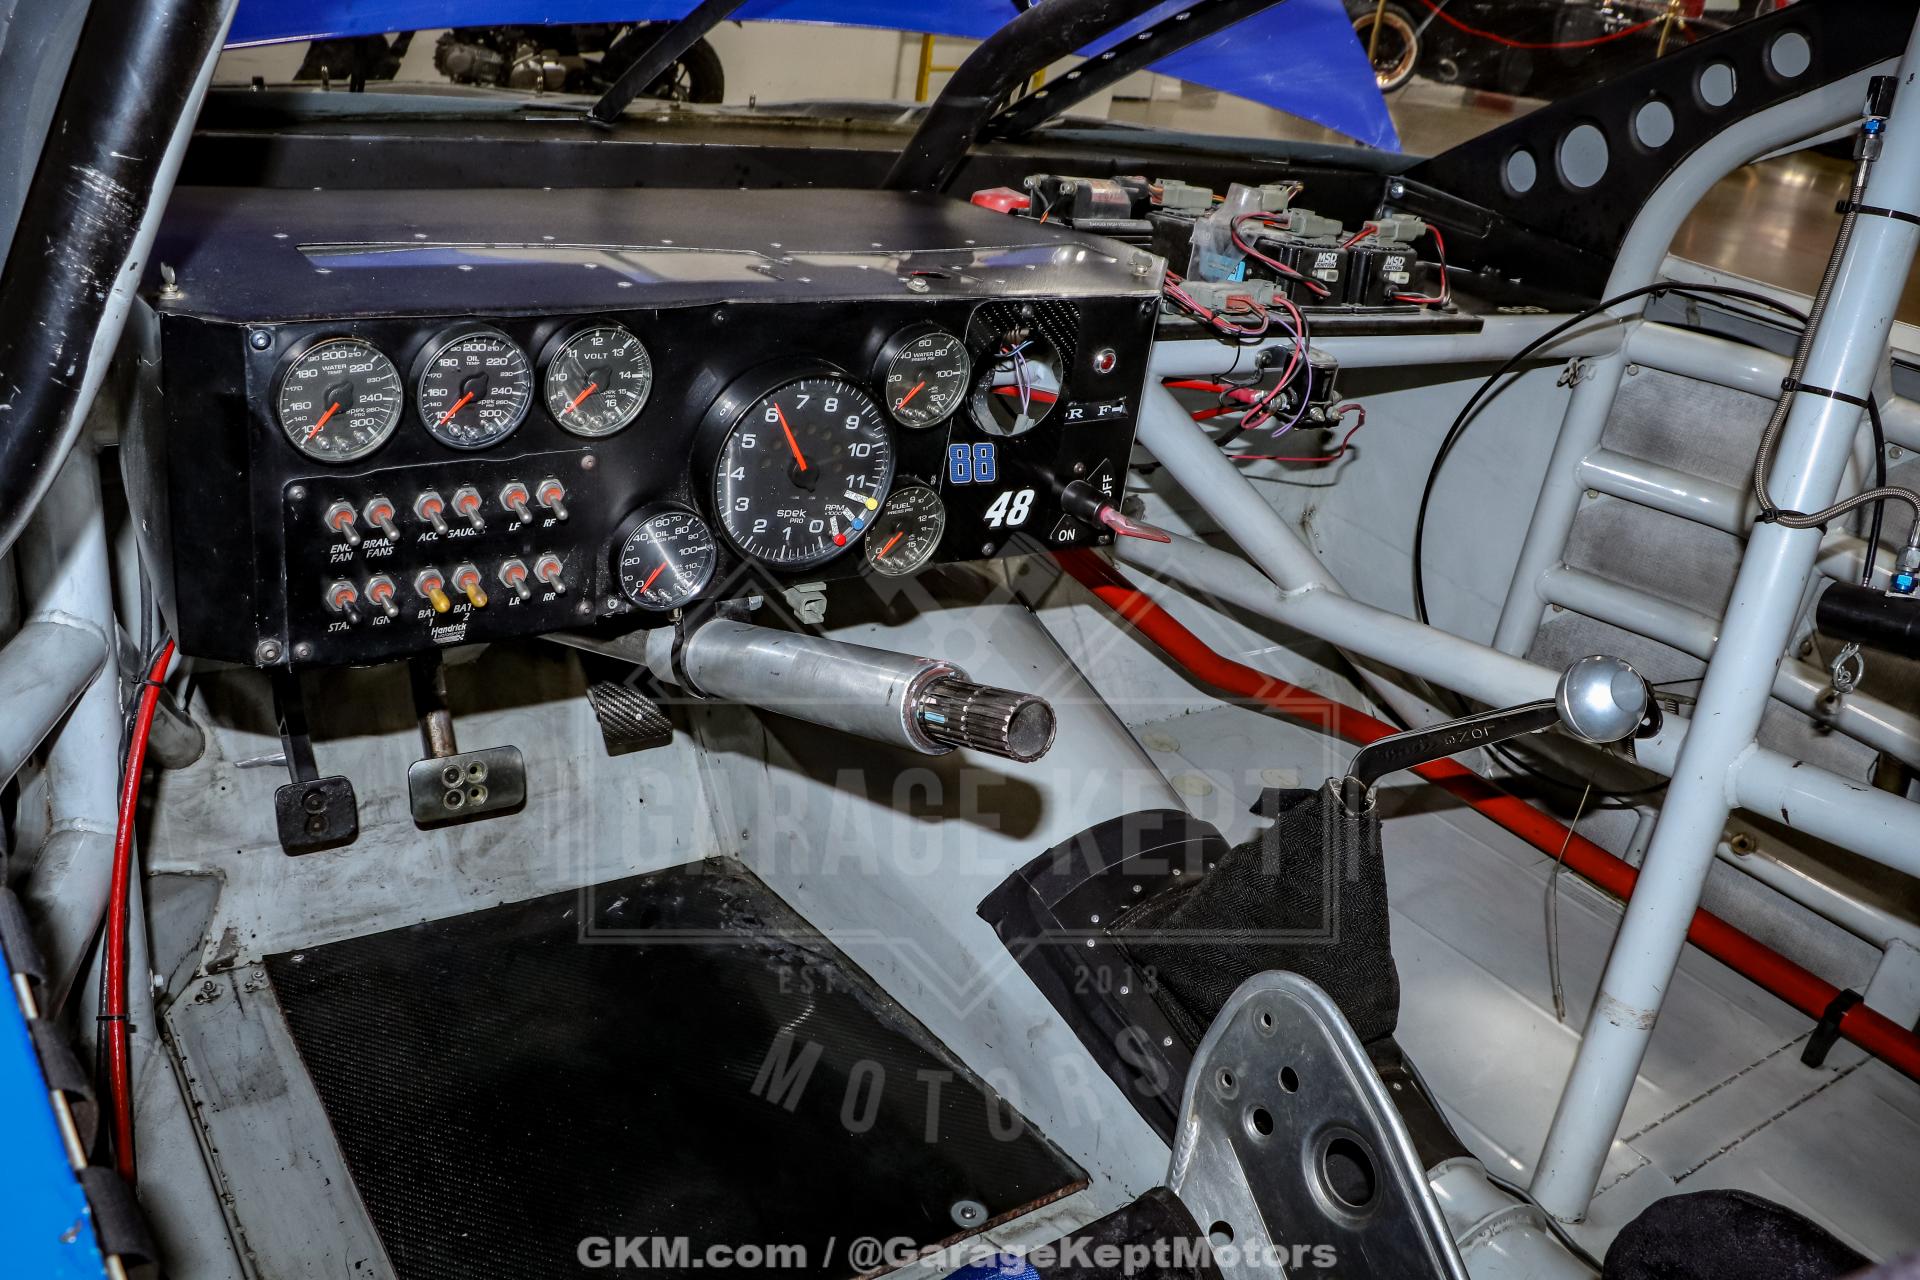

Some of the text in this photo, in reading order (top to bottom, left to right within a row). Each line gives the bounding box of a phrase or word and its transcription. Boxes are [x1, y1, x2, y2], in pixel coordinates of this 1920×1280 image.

[1319, 253, 1338, 262] MSD
[1386, 256, 1405, 265] MSD
[591, 337, 603, 346] 12
[919, 339, 931, 347] 60
[463, 343, 487, 352] 200
[612, 348, 624, 356] 13
[322, 351, 347, 360] 200
[567, 350, 577, 358] 11
[935, 349, 947, 357] 80
[438, 358, 458, 367] 180
[486, 358, 508, 366] 220
[350, 363, 373, 373] 220
[296, 369, 318, 379] 180
[554, 373, 568, 381] 10
[619, 371, 631, 379] 14
[889, 374, 902, 382] 20
[936, 370, 952, 378] 100
[428, 388, 447, 396] 160
[492, 387, 512, 395] 240
[360, 393, 382, 403] 240
[605, 399, 616, 407] 16
[796, 394, 810, 410] 7
[290, 402, 311, 411] 160
[565, 401, 574, 409] 0
[824, 398, 839, 413] 8
[479, 410, 502, 418] 300
[765, 408, 779, 423] 6
[1068, 409, 1083, 419] R
[350, 418, 374, 428] 300
[845, 416, 860, 430] 9
[741, 434, 757, 449] 5
[848, 443, 871, 458] 10
[949, 442, 996, 484] 88
[730, 466, 745, 481] 4
[846, 475, 866, 489] 11
[735, 497, 750, 512] 3
[984, 489, 1036, 528] 48
[777, 509, 807, 518] spek
[509, 522, 521, 532] LF
[543, 518, 557, 528] RF
[656, 518, 670, 527] 60
[752, 518, 768, 533] 2
[809, 520, 824, 533] 0
[448, 526, 486, 538] GAUG
[675, 526, 689, 535] 80
[783, 527, 792, 541] 1
[1058, 529, 1075, 541] ON
[633, 533, 648, 542] 40
[362, 538, 391, 549] BRAK
[366, 546, 394, 558] FANS
[679, 546, 698, 556] 100
[330, 552, 353, 563] FAN
[624, 557, 640, 566] 20
[509, 596, 520, 606] LR
[542, 592, 556, 602] RR
[453, 603, 476, 613] BAT
[429, 618, 433, 626] 1
[463, 613, 470, 621] 2
[328, 622, 350, 632] STA
[431, 623, 467, 639] Hendrick
